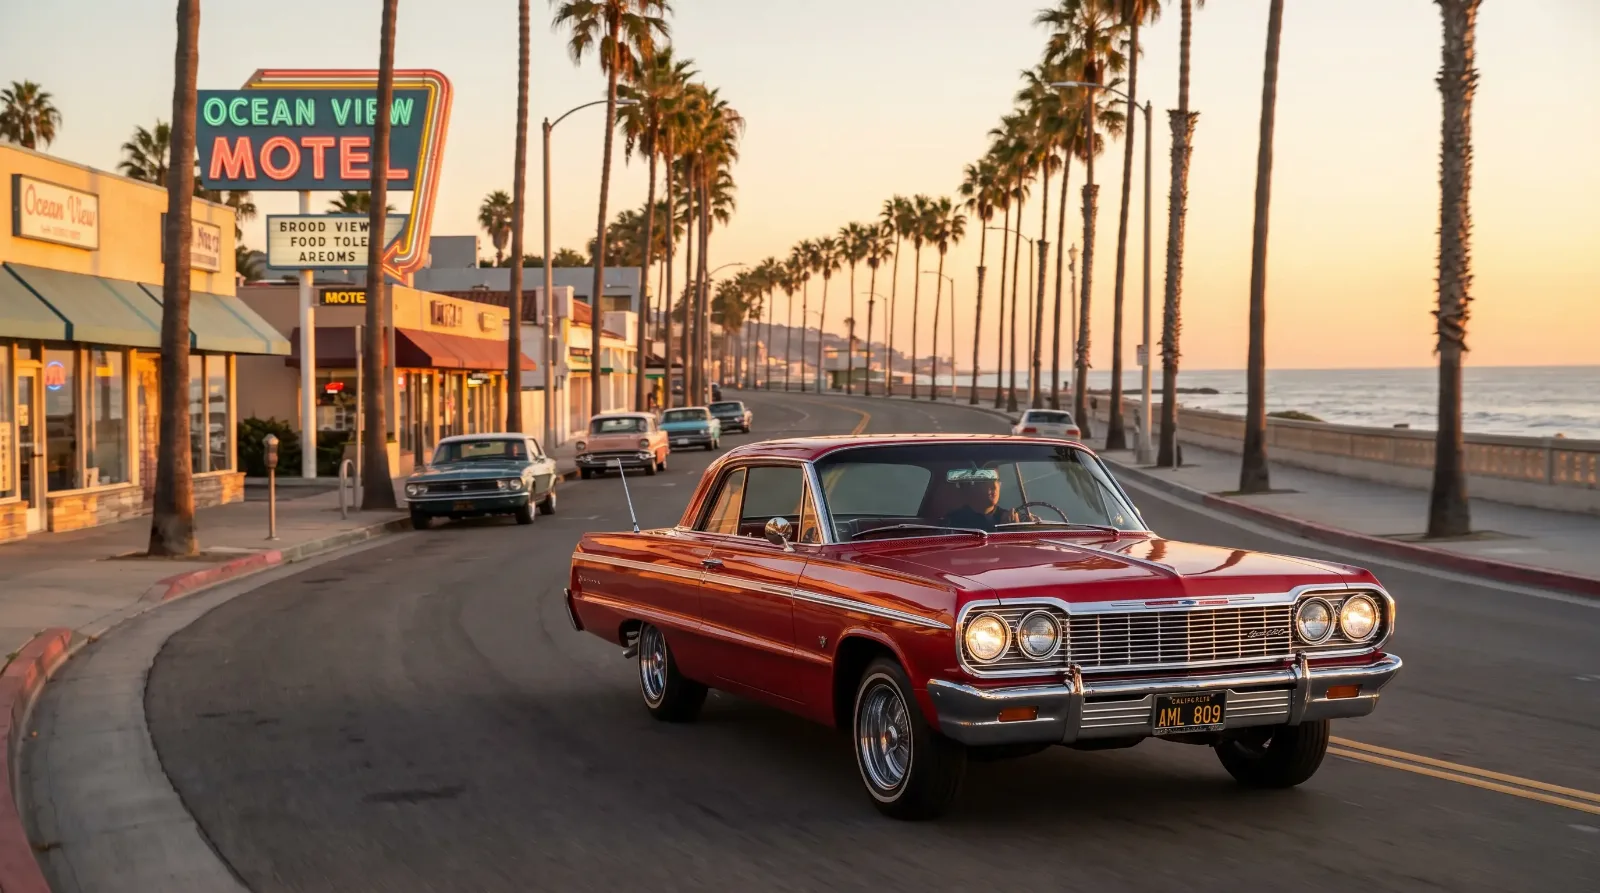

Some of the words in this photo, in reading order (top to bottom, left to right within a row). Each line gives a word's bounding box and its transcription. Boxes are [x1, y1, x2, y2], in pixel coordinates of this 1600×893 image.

[203, 97, 315, 126] OCEAN
[331, 98, 414, 126] VIEW
[25, 184, 64, 220] Ocean
[67, 195, 96, 227] View
[335, 222, 369, 232] VIEW
[290, 237, 326, 247] FOOD
[334, 237, 368, 247] TOLE
[299, 251, 356, 262] AREOMS
[1158, 707, 1185, 727] AML
[1193, 704, 1221, 724] 809
